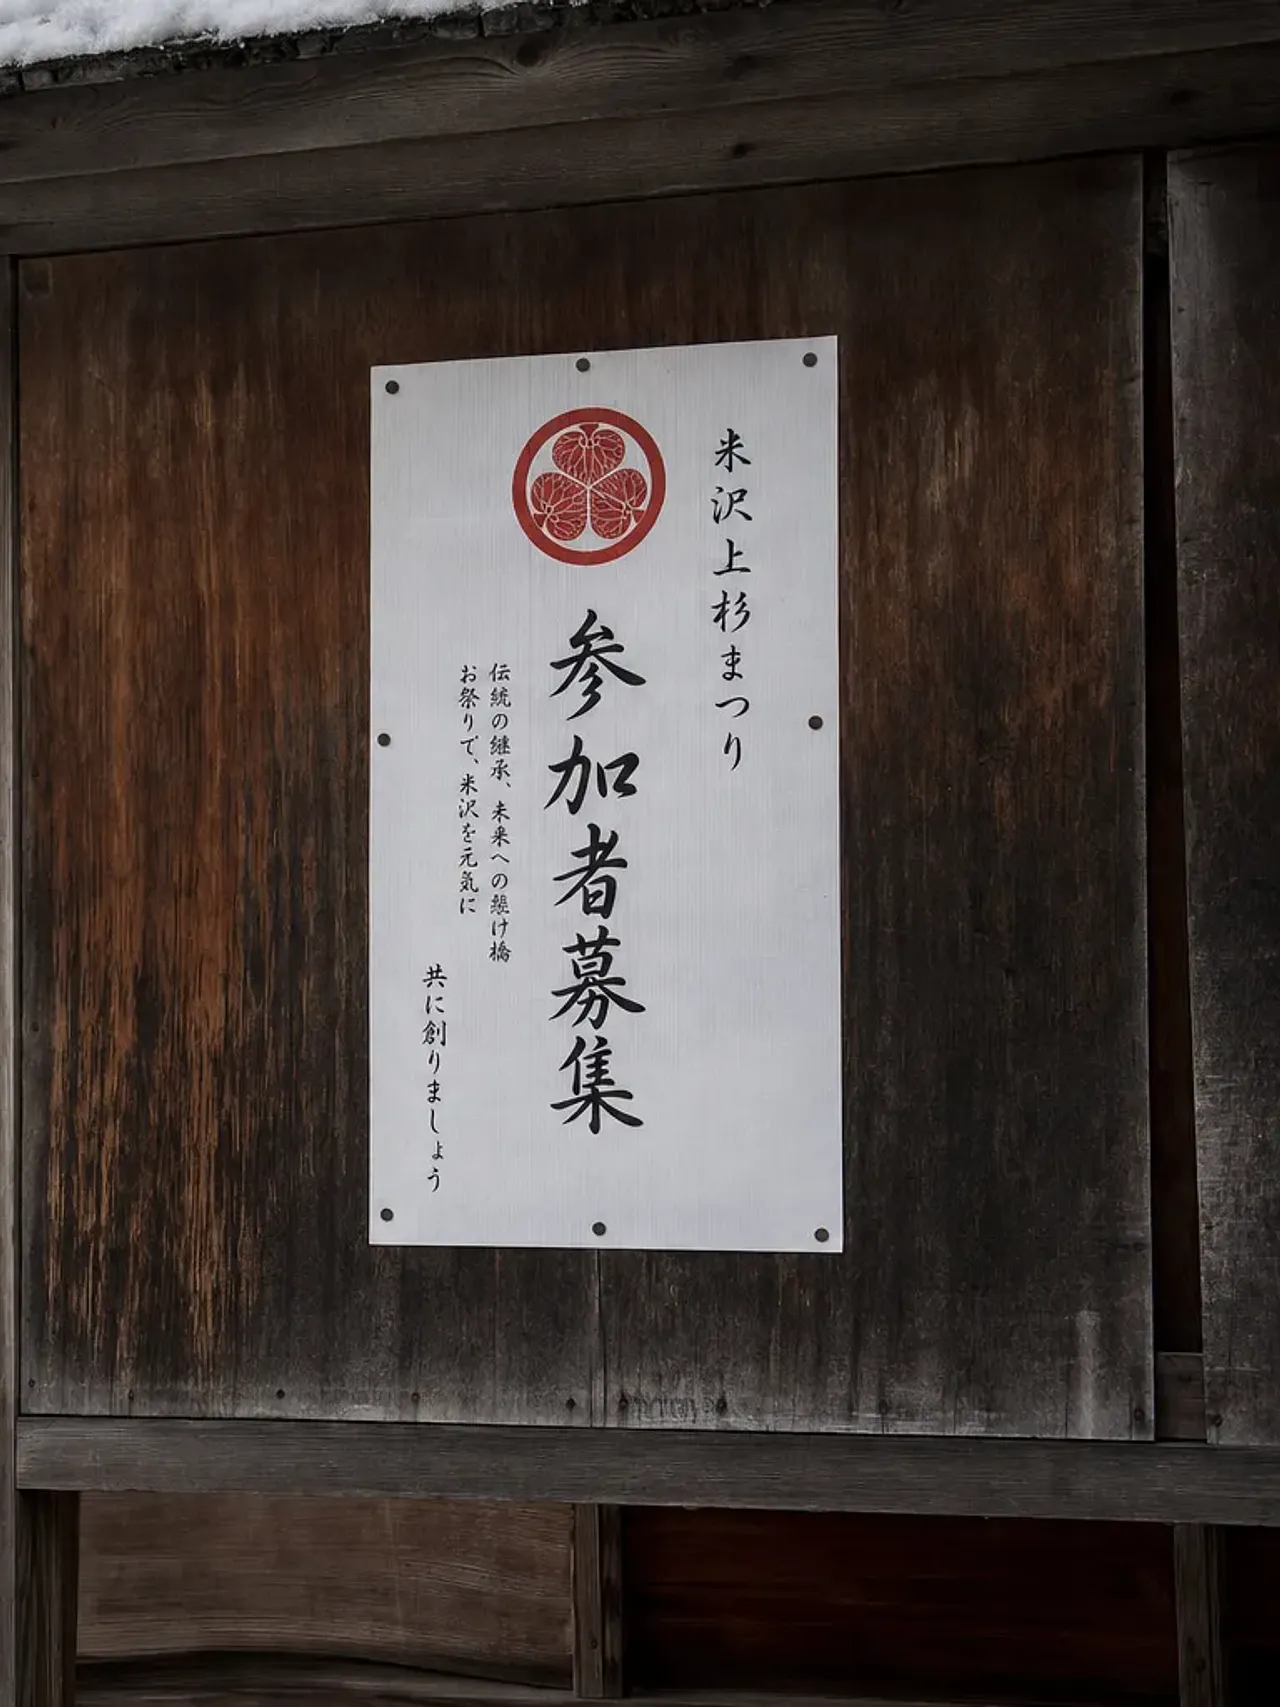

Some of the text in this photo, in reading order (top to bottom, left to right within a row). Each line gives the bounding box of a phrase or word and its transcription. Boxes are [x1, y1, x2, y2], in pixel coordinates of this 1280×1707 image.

[710, 427, 753, 771] 米沢上杉まつり
[458, 664, 480, 915] お祭りで、米沢を元気に
[543, 608, 647, 1135] 参加者募集
[422, 963, 448, 1193] 共に創りましょう
